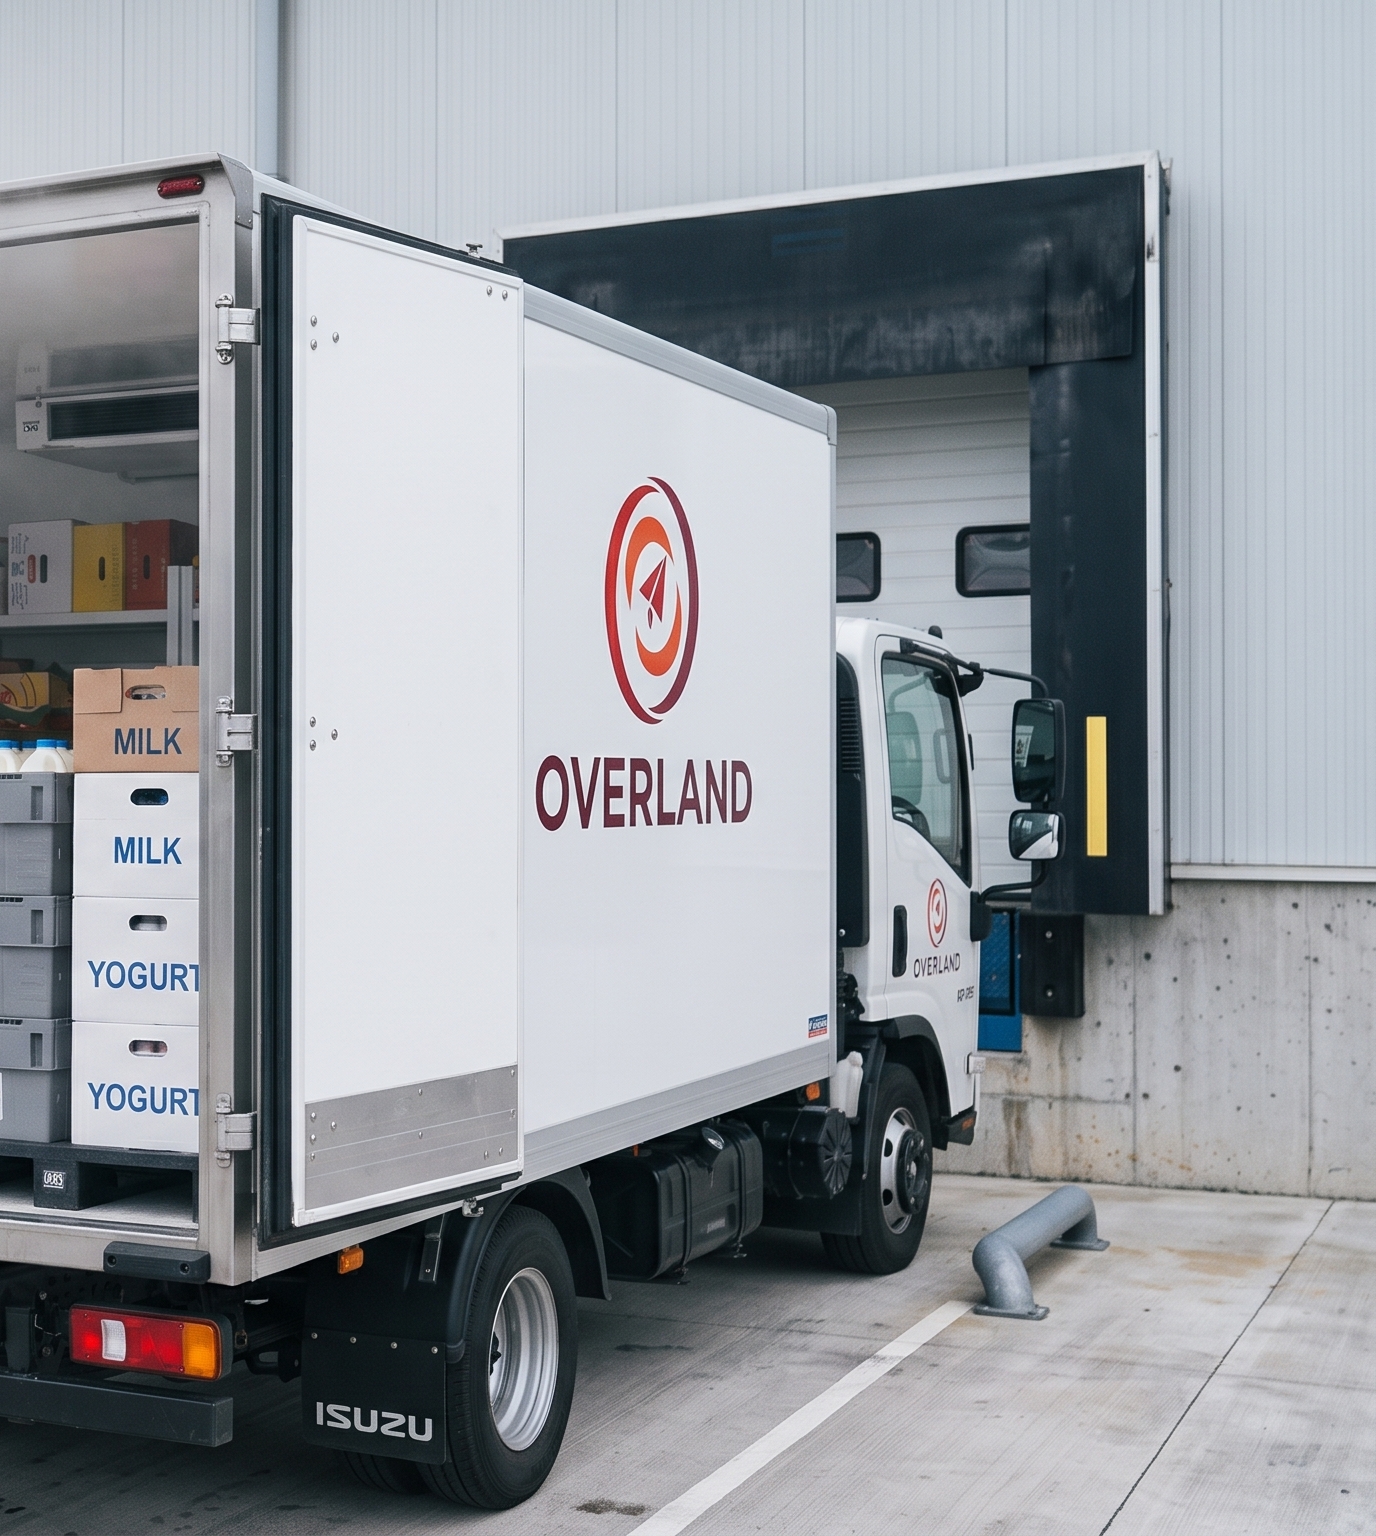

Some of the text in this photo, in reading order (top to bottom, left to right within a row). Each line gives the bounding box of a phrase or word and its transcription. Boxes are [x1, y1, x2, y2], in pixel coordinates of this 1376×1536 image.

[114, 727, 183, 755] MILK
[535, 754, 753, 832] OVERLAND
[114, 836, 183, 865] MILK
[87, 960, 200, 992] YOGURT
[913, 952, 961, 978] OVERLAND
[87, 1082, 200, 1116] YOGURT
[316, 1401, 433, 1442] ISUZU
